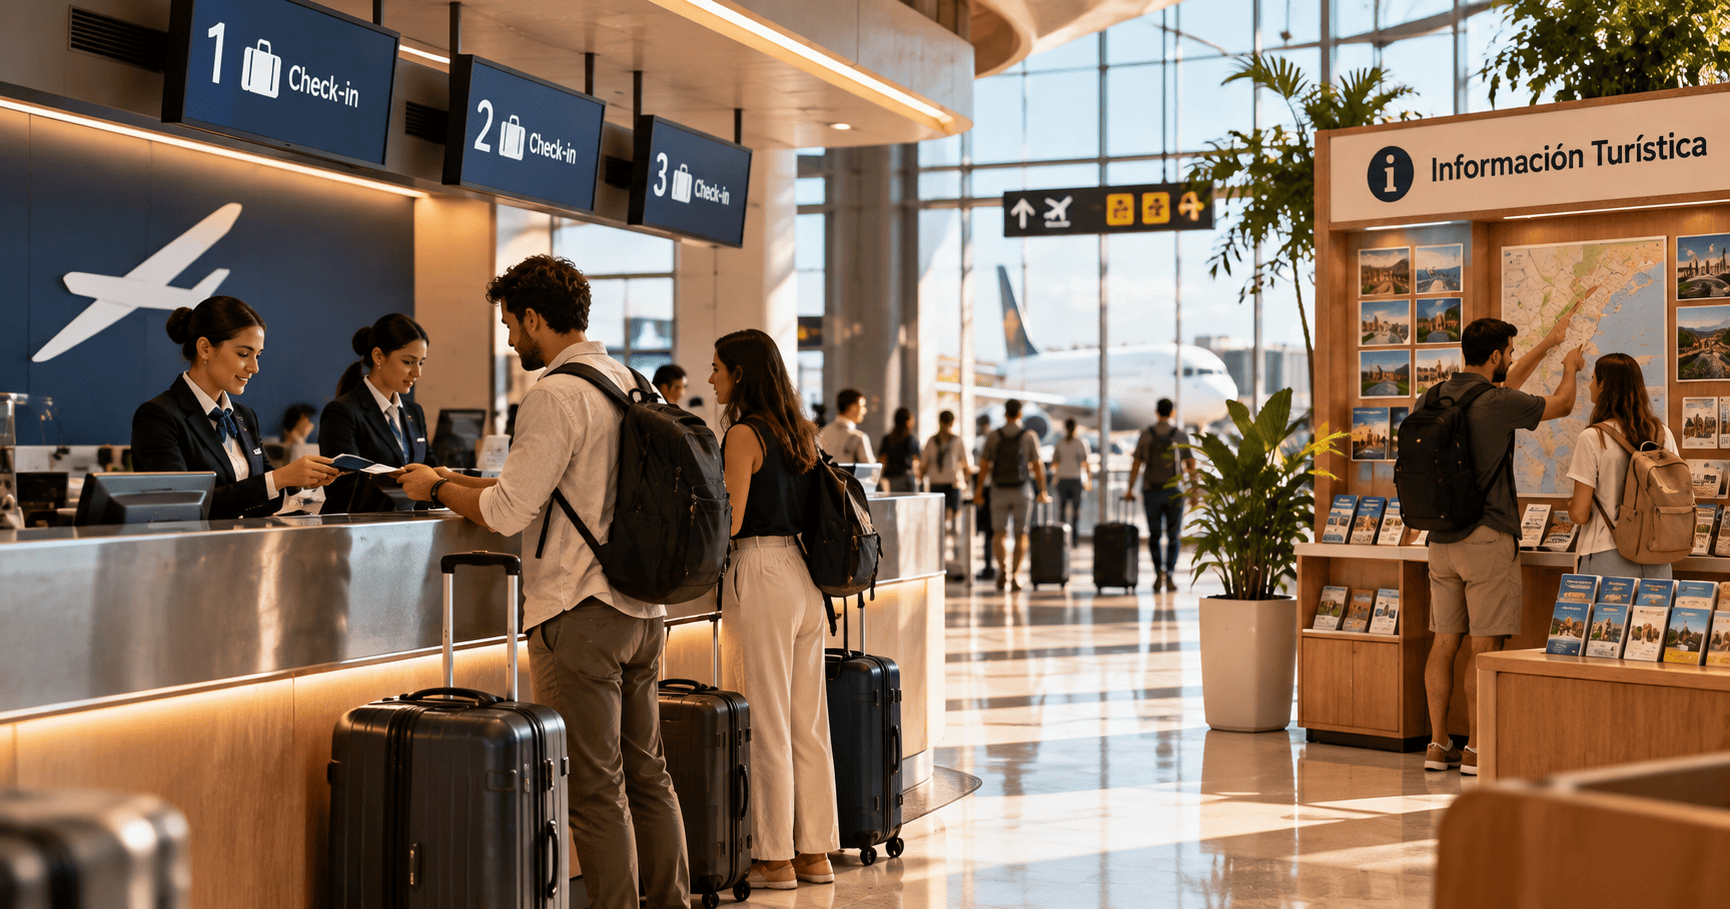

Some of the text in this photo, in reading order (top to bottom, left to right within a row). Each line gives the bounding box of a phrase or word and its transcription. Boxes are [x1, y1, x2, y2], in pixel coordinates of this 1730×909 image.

[207, 21, 359, 108] 1 Check-in
[473, 98, 577, 165] 2 Check-in
[1431, 131, 1708, 183] Información Turística
[653, 151, 730, 206] 3 Check-in
